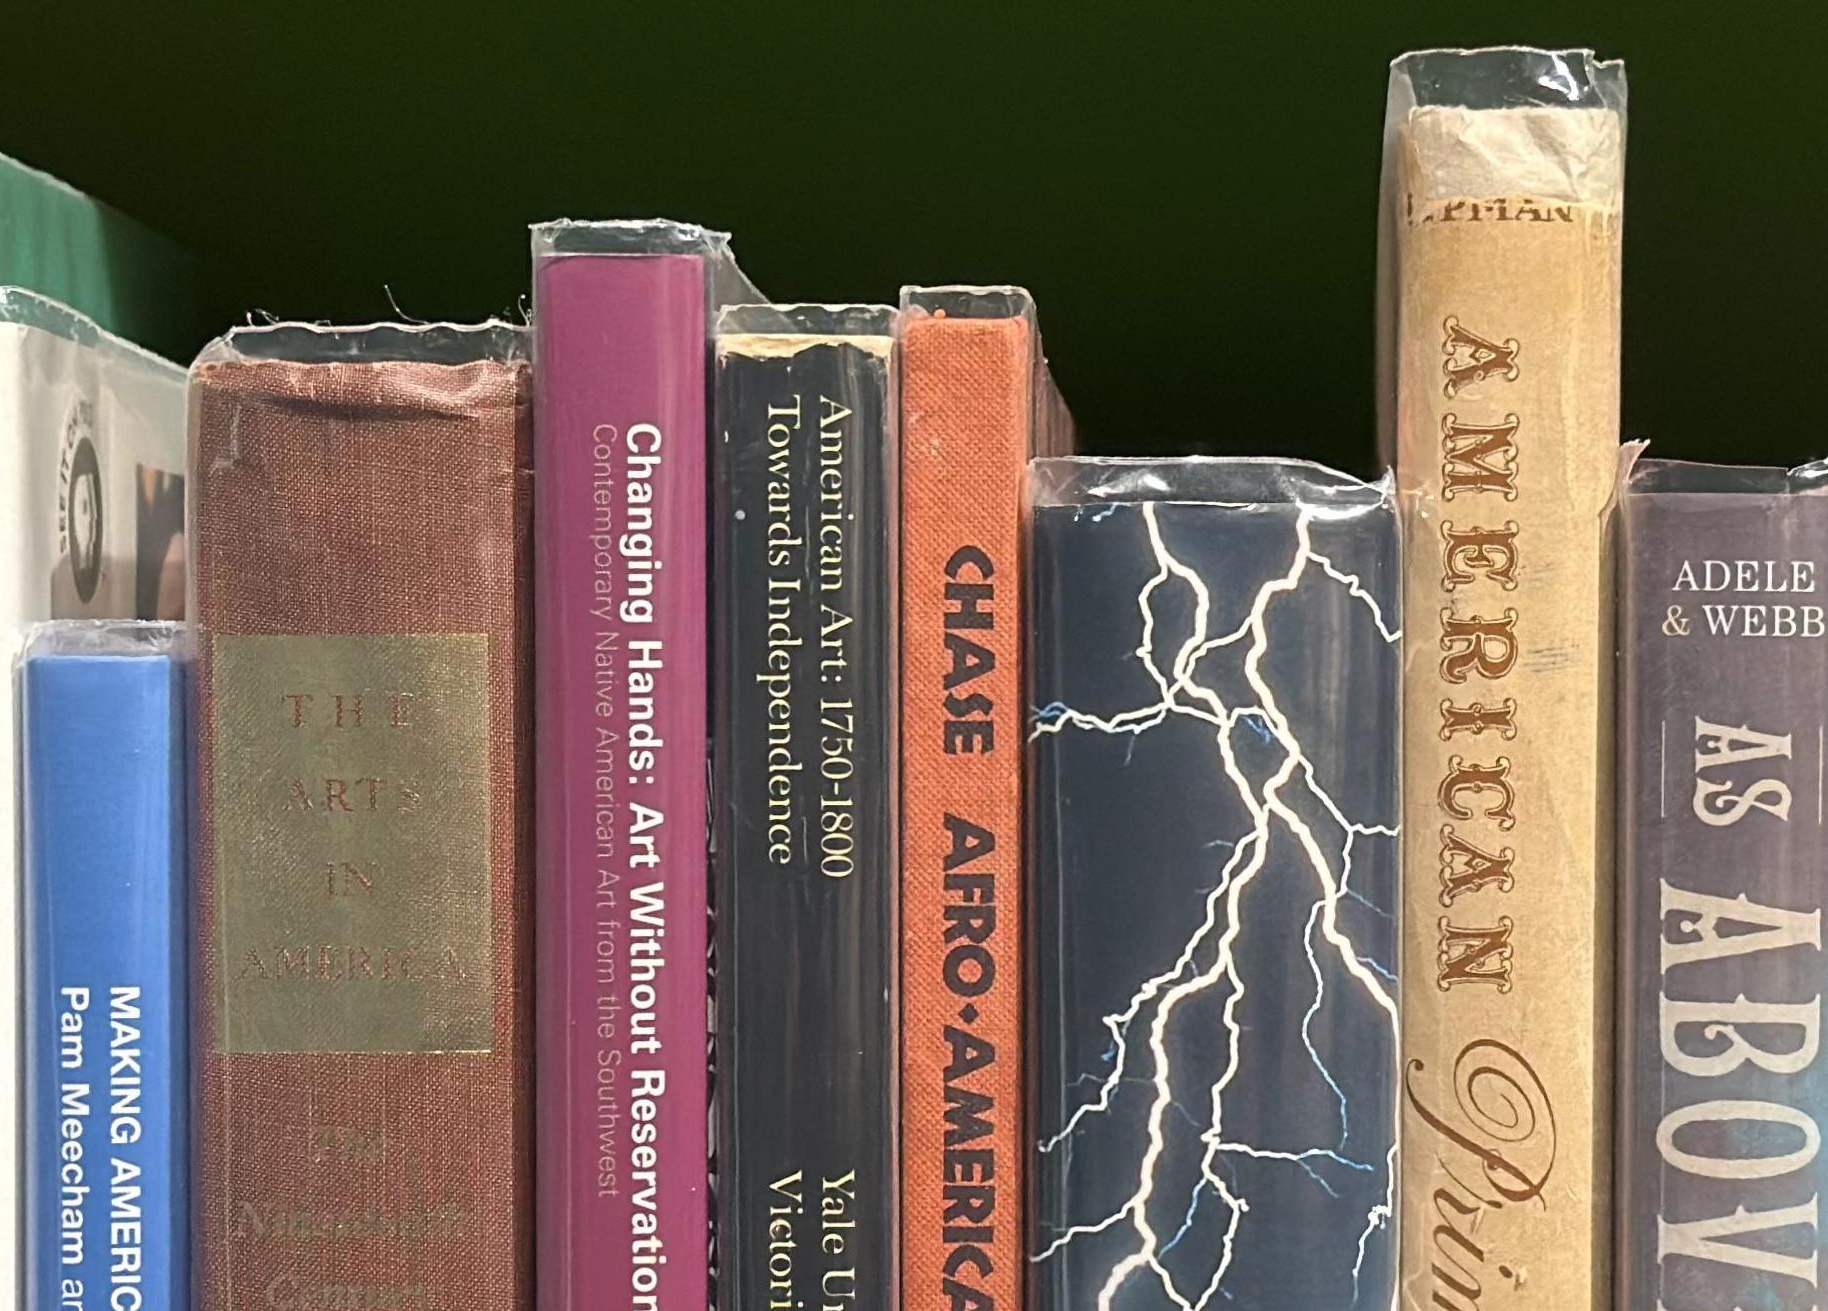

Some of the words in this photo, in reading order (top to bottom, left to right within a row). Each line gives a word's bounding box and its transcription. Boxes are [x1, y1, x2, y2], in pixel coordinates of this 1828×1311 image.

[590, 424, 617, 619] Contemporary
[620, 424, 662, 622] Changing
[768, 394, 802, 565] Towards
[820, 396, 854, 590] American
[821, 605, 853, 681] Art:
[1673, 560, 1815, 592] ADELE
[1703, 605, 1825, 637] WEBB
[595, 632, 619, 717] Native
[628, 641, 663, 783] Hands:
[757, 579, 802, 864] Independence
[943, 544, 995, 755] CHASE
[1436, 315, 1520, 994] AMERICAN
[596, 728, 620, 857] American
[630, 803, 663, 867] Art
[1691, 716, 1792, 825] AS
[597, 870, 620, 908] Art
[61, 988, 89, 1068] Pam
[630, 882, 664, 1053] Without
[110, 987, 141, 1143] MAKING
[593, 1048, 625, 1199] Southwest
[62, 1084, 90, 1264] Meecham
[822, 1169, 855, 1253] Yale
